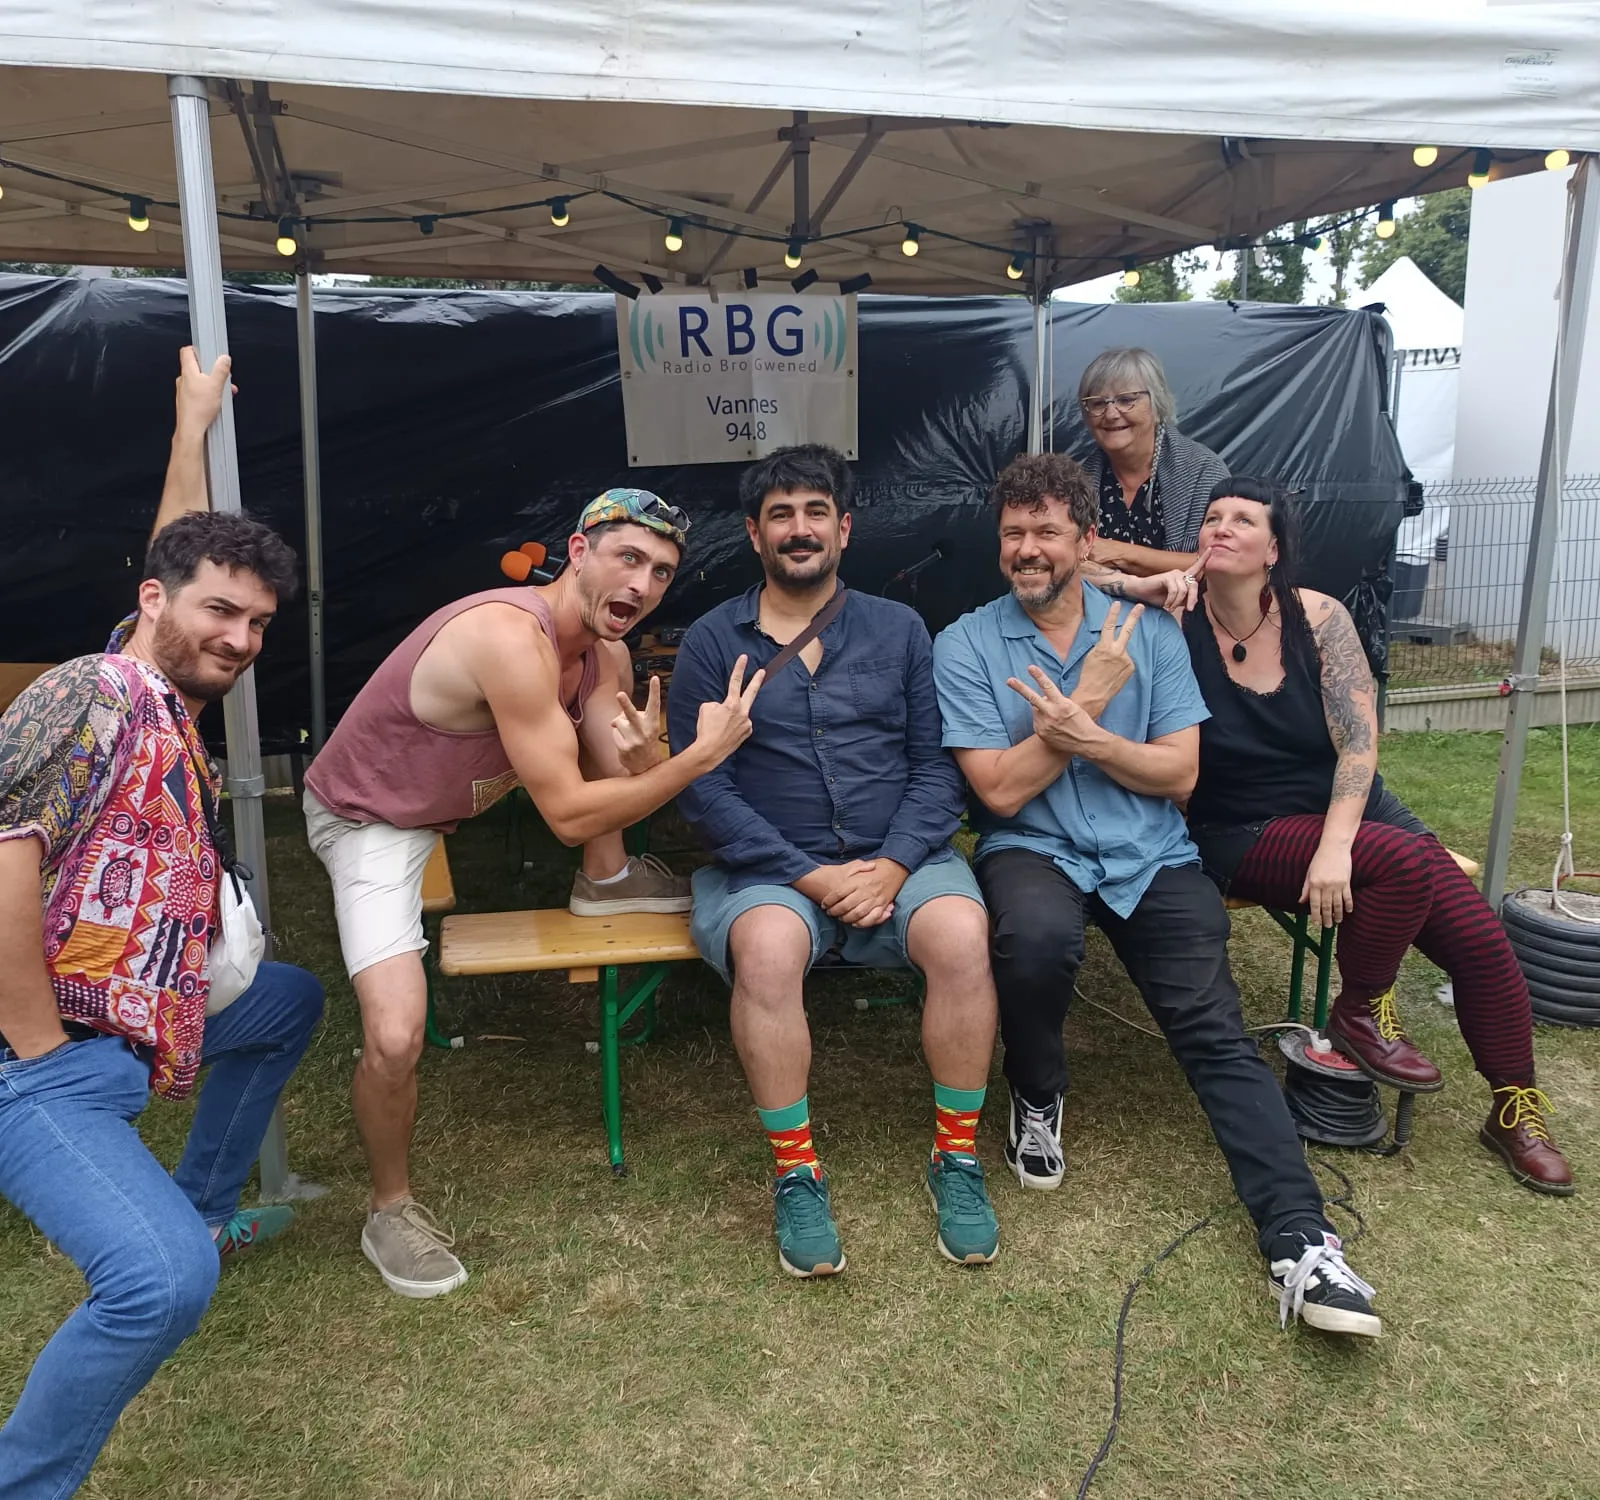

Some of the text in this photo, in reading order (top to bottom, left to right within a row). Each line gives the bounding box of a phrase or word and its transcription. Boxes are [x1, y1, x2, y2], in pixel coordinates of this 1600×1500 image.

[678, 304, 804, 358] RBG
[663, 359, 817, 374] Radio Bro Gwened
[1399, 347, 1461, 367] TIVY
[706, 395, 778, 416] Vannes
[726, 421, 767, 442] 94.8
